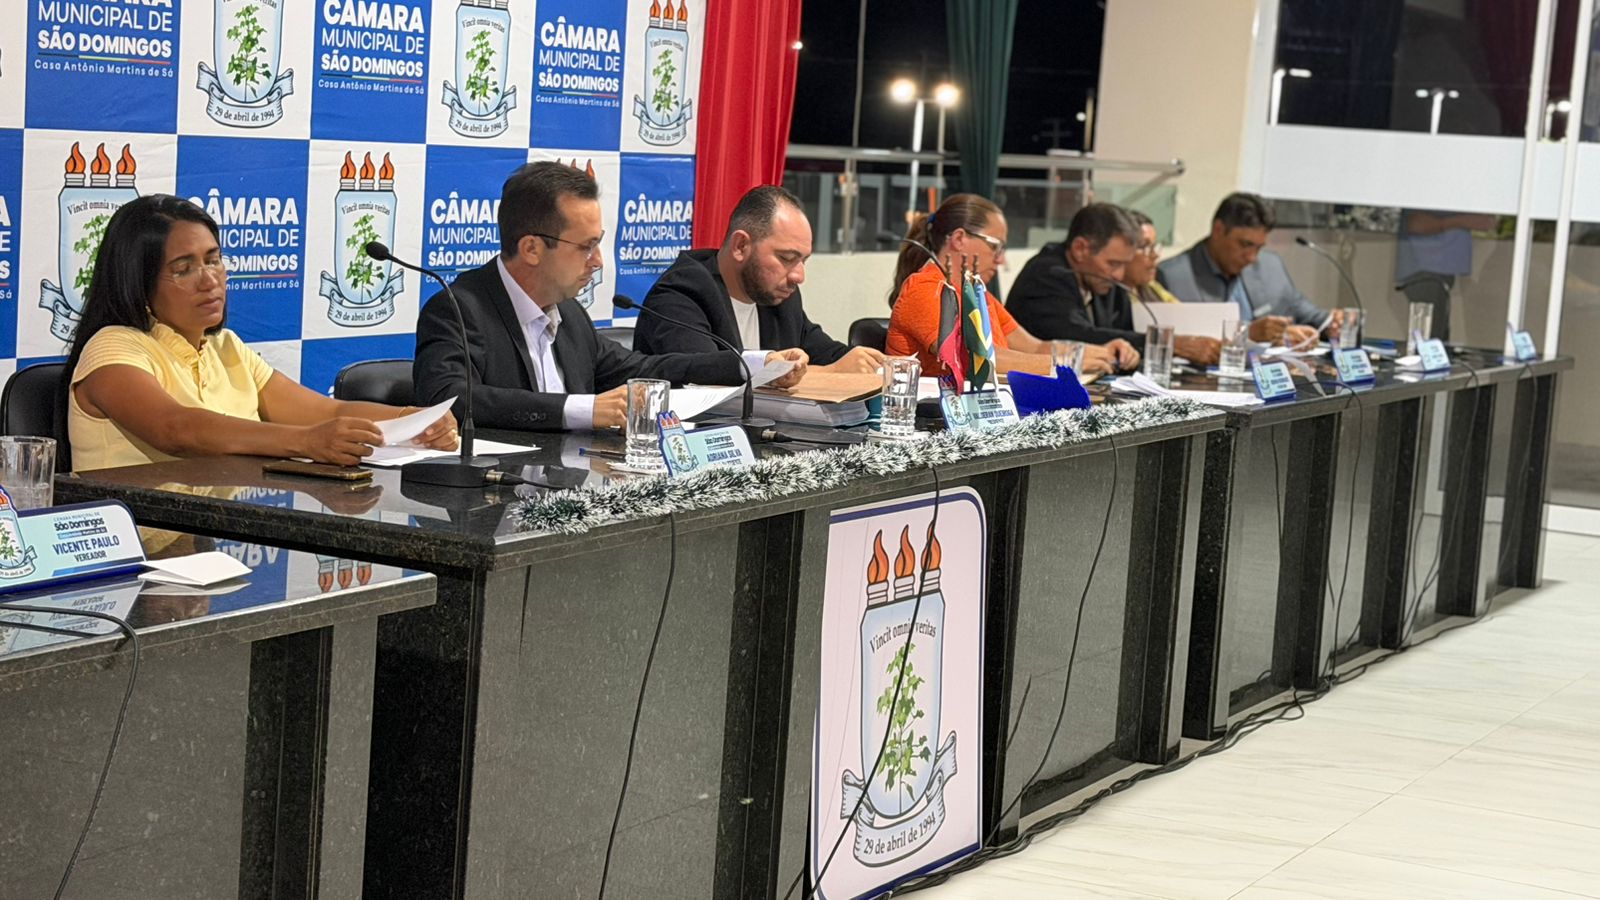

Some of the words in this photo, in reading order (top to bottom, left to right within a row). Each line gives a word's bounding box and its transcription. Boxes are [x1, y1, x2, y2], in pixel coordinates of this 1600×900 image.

[38, 1, 143, 30] MUNICIPAL
[148, 10, 173, 32] DE
[37, 25, 75, 51] SÃO
[79, 33, 172, 58] DOMINGOS
[321, 27, 402, 53] MUNICIPAL
[405, 36, 425, 55] DE
[540, 15, 621, 53] CÂMARA
[34, 59, 61, 70] Casa
[63, 61, 105, 73] Antônio
[106, 64, 146, 76] Martins
[148, 67, 160, 77] de
[161, 68, 174, 78] Sá
[320, 49, 350, 72] SÃO
[352, 56, 424, 78] DOMINGOS
[539, 49, 603, 71] MUNICIPAL
[604, 55, 621, 72] DE
[318, 79, 339, 89] Casa
[340, 80, 372, 91] Antônio
[372, 83, 403, 93] Martins
[403, 85, 414, 94] de
[414, 86, 425, 95] Sá
[538, 68, 562, 87] SÃO
[562, 74, 619, 92] DOMINGOS
[215, 106, 223, 116] 29
[224, 110, 232, 120] de
[233, 111, 250, 122] abril
[251, 112, 259, 122] de
[260, 109, 275, 121] 1994
[623, 193, 693, 224] CÂMARA
[219, 228, 274, 248] ICIPAL
[278, 228, 300, 247] DE
[429, 227, 501, 245] MUNICIPAL
[621, 225, 678, 241] MUNICIPAL
[680, 225, 692, 240] DE
[428, 246, 454, 267] SÃO
[619, 243, 642, 261] SÃO
[241, 281, 275, 290] Martins
[276, 280, 287, 289] de
[289, 279, 300, 288] Sá
[343, 311, 351, 321] de
[366, 311, 374, 321] de
[60, 323, 70, 335] 29
[54, 521, 70, 531] São
[69, 517, 105, 530] Domingos
[52, 539, 92, 556] VICENTE
[90, 534, 120, 550] PAULO
[74, 550, 107, 562] VEREADOR
[869, 625, 892, 653] Vincit
[892, 617, 912, 638] omni
[915, 618, 937, 638] veritas
[863, 838, 875, 855] 29
[875, 838, 886, 854] de
[886, 830, 906, 852] abril
[907, 827, 918, 843] de
[918, 811, 936, 837] 1994
